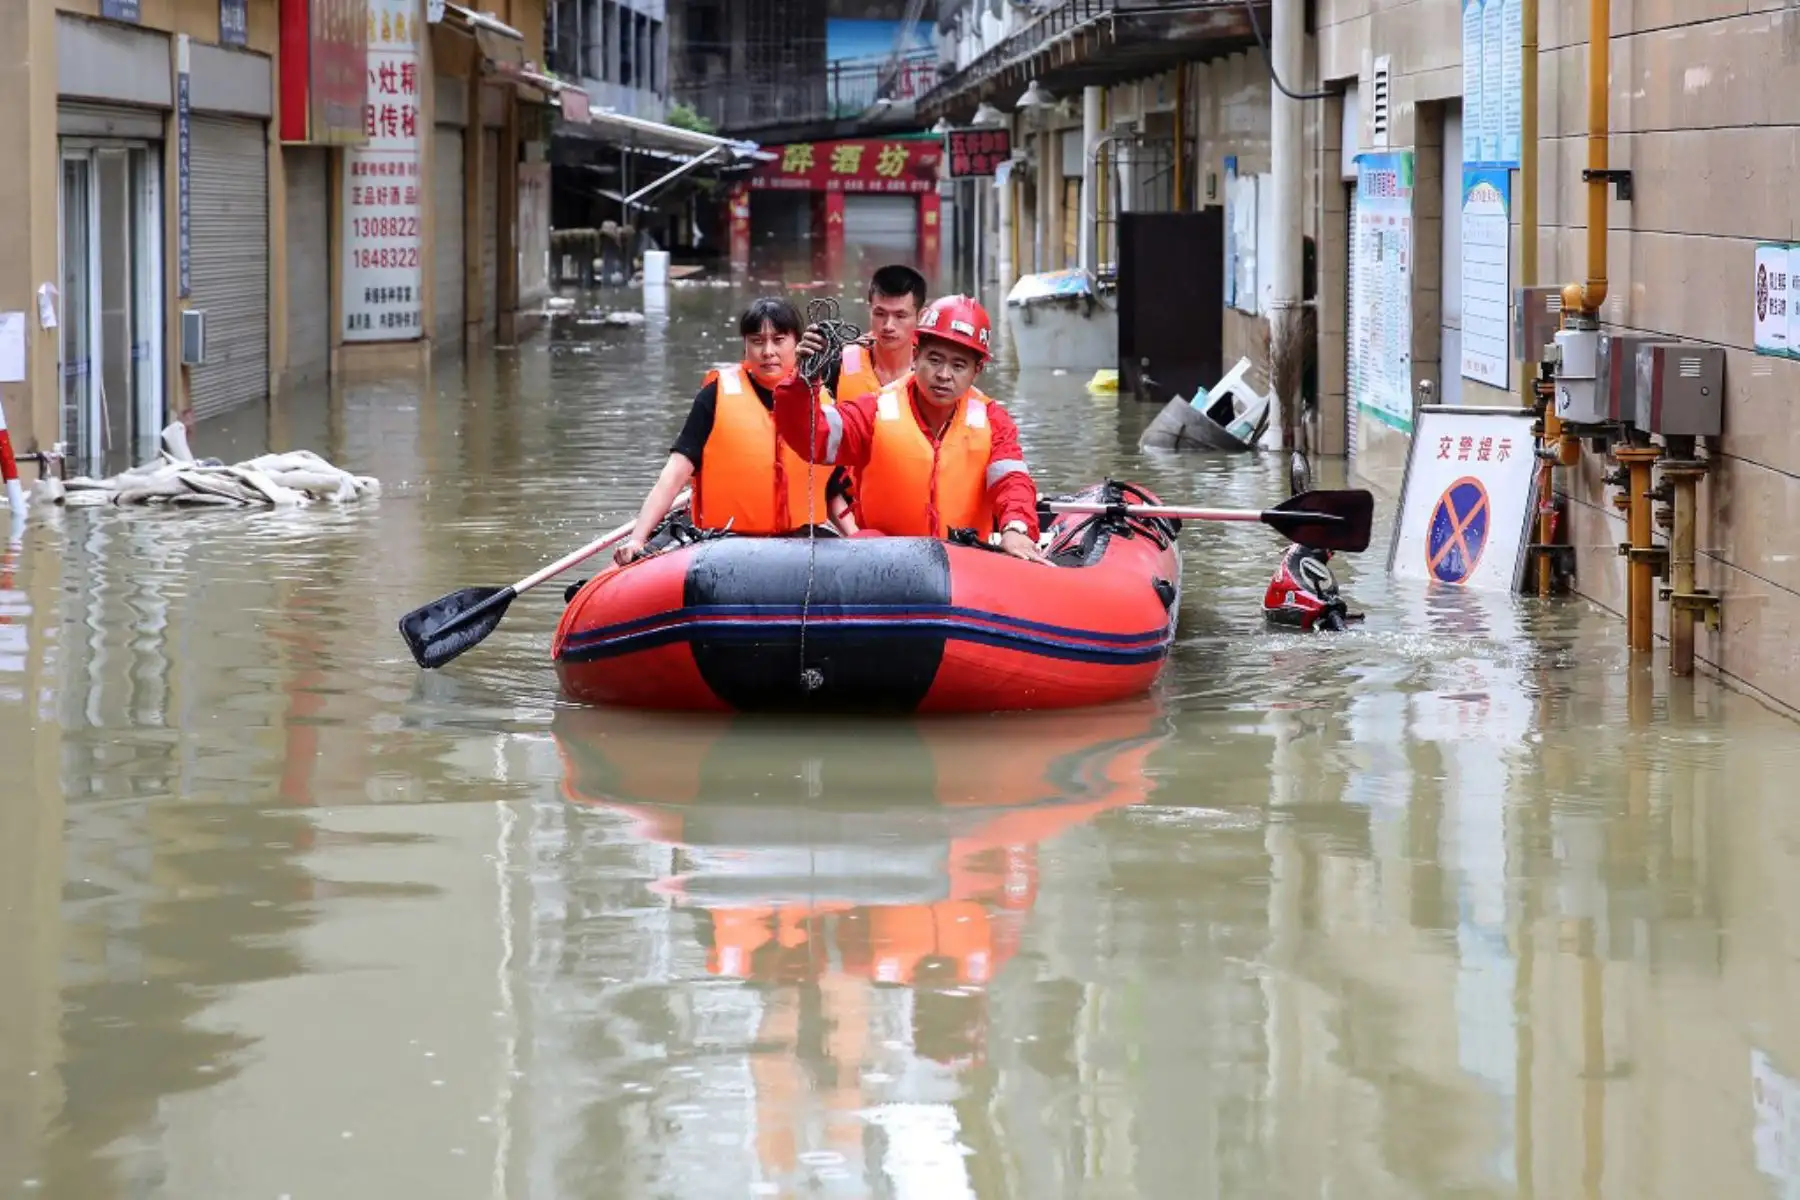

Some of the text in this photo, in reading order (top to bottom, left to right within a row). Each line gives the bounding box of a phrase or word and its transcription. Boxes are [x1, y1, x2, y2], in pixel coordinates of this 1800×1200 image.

[404, 186, 421, 205] 品
[353, 217, 418, 237] 1308822
[353, 248, 419, 268] 1848322
[1437, 436, 1512, 462] 交警提示
